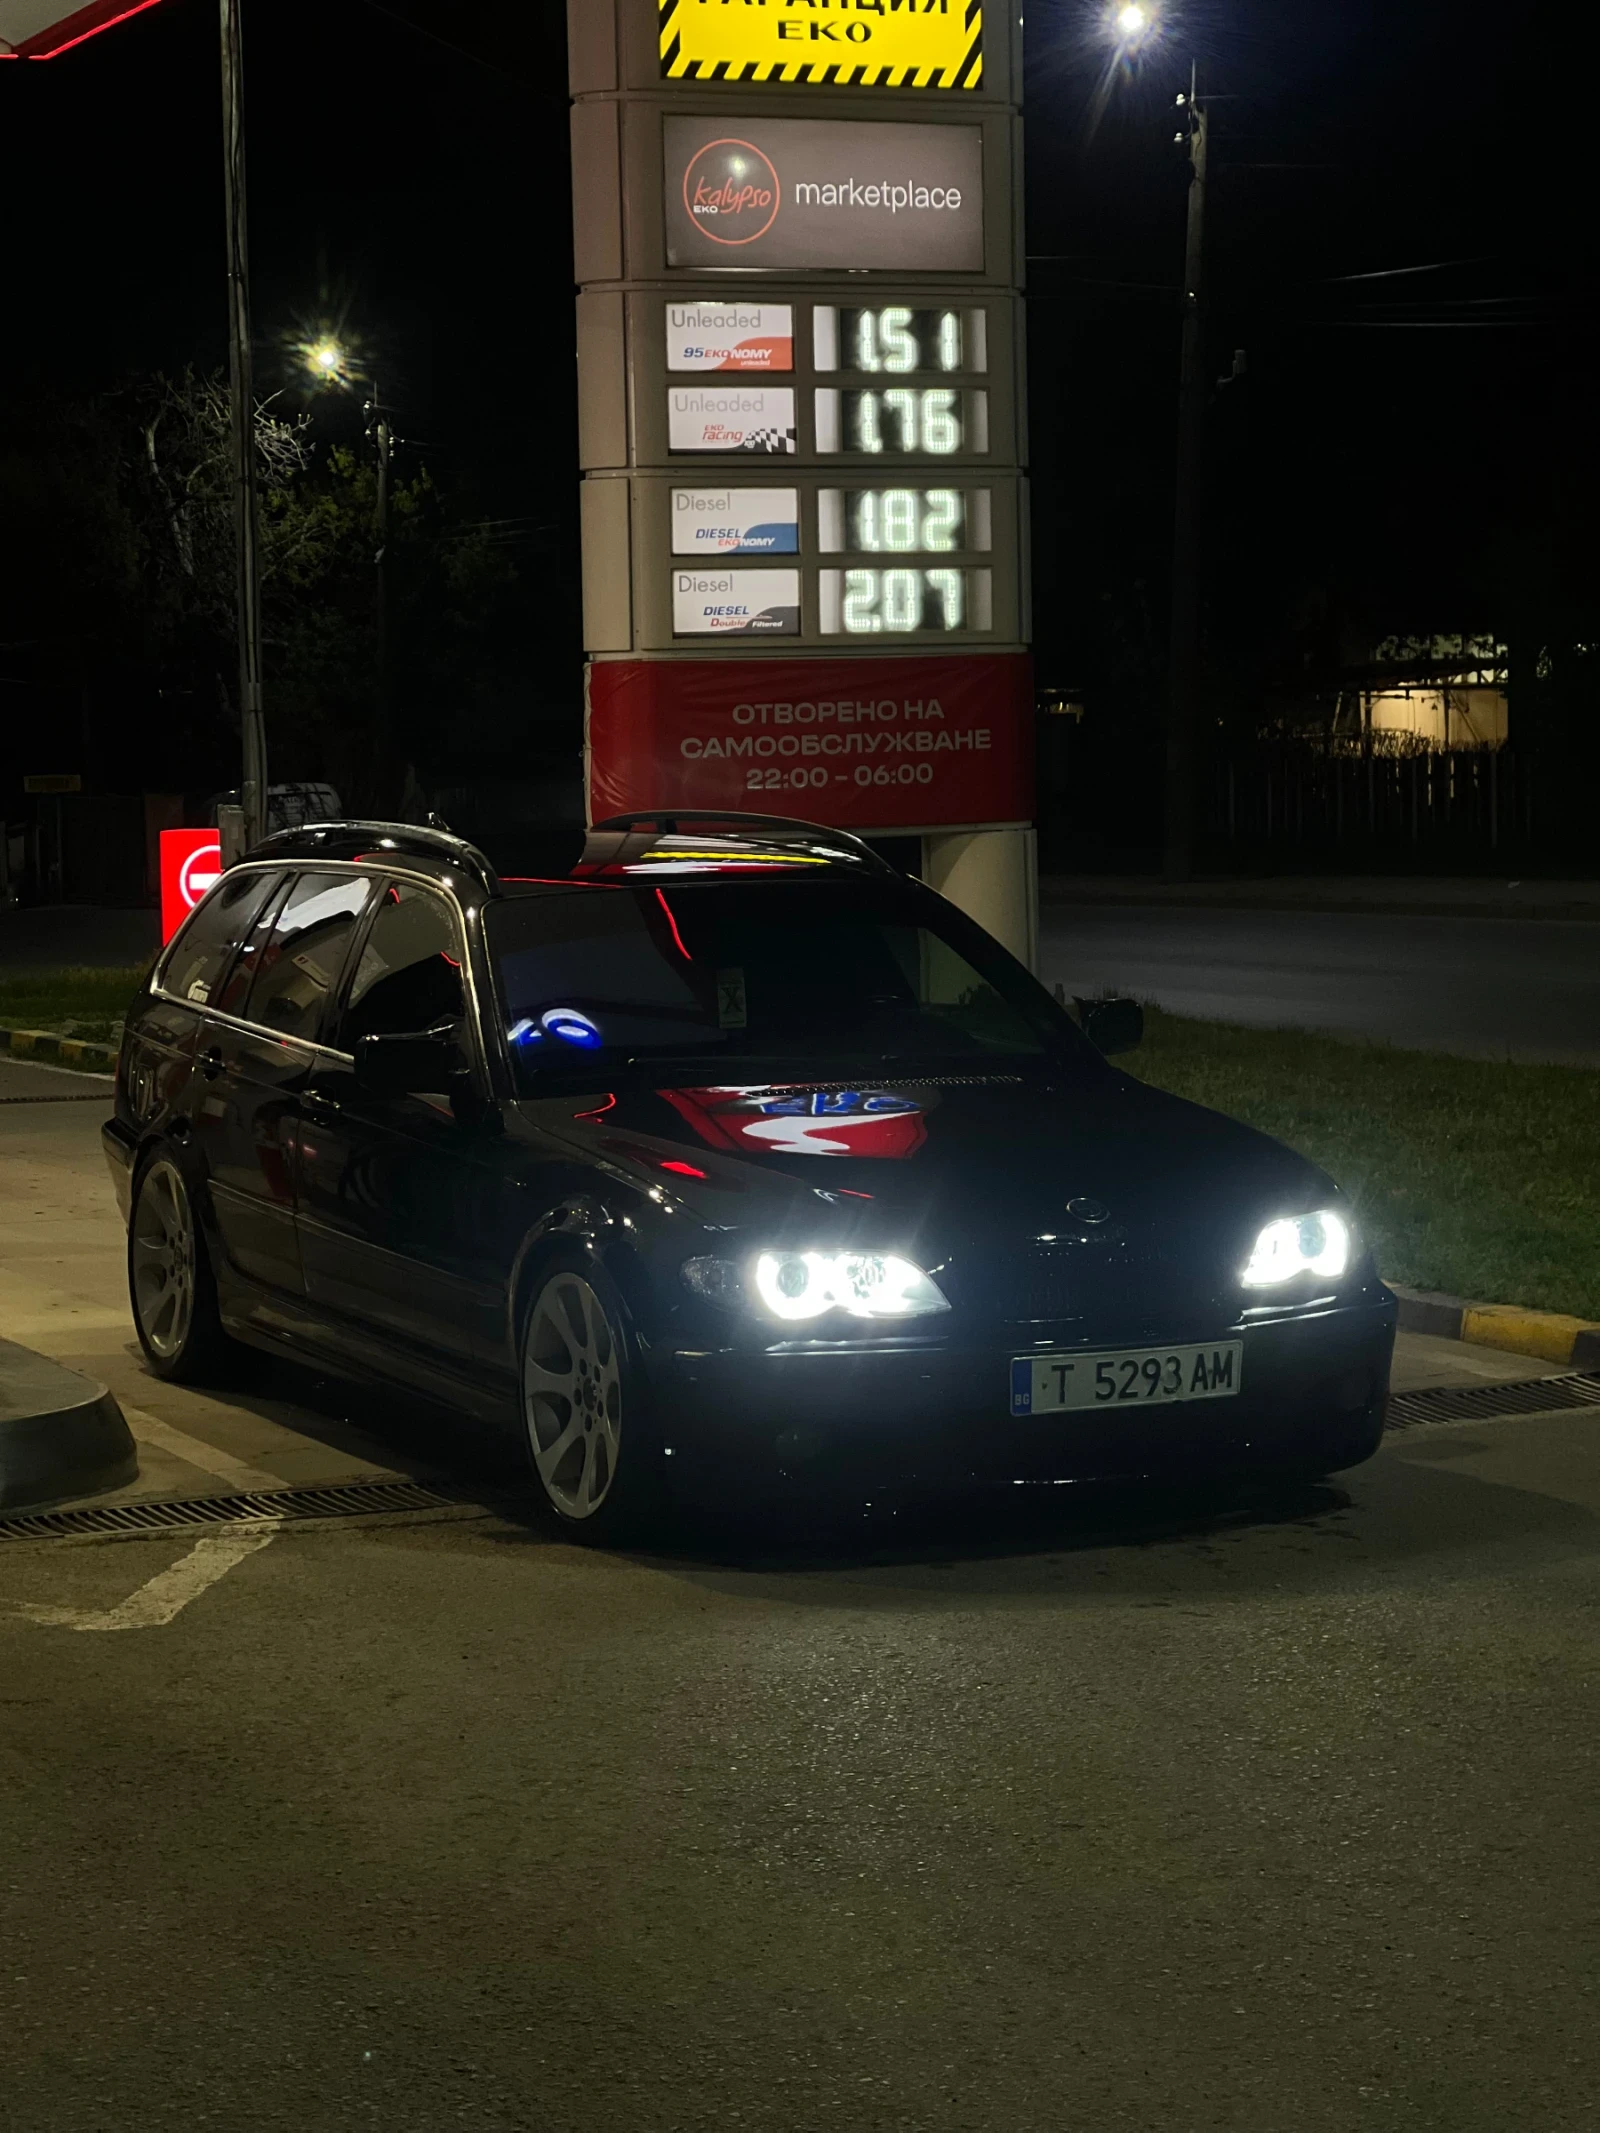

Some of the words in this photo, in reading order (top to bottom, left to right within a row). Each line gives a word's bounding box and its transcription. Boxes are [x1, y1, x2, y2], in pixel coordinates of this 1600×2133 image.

[795, 177, 962, 213] marketplace
[693, 205, 718, 214] EKO
[671, 308, 761, 328] Unleaded
[674, 393, 765, 413] Unleaded
[702, 431, 743, 443] racing
[676, 491, 731, 511] Diesel
[695, 528, 742, 539] DIESEL
[718, 537, 775, 547] EKONOMY
[678, 572, 733, 593] Diesel
[703, 606, 749, 616] DIESEL
[732, 700, 898, 725] ОТВОРЕНО
[904, 698, 945, 720] НА
[680, 729, 992, 759] САМООБСЛУЖВАНЕ
[746, 766, 829, 789] 22:00
[854, 763, 934, 787] 06:00
[1051, 1363, 1075, 1404] T
[1095, 1356, 1182, 1400] 5293
[1190, 1350, 1234, 1392] AM
[1014, 1393, 1030, 1406] BG
